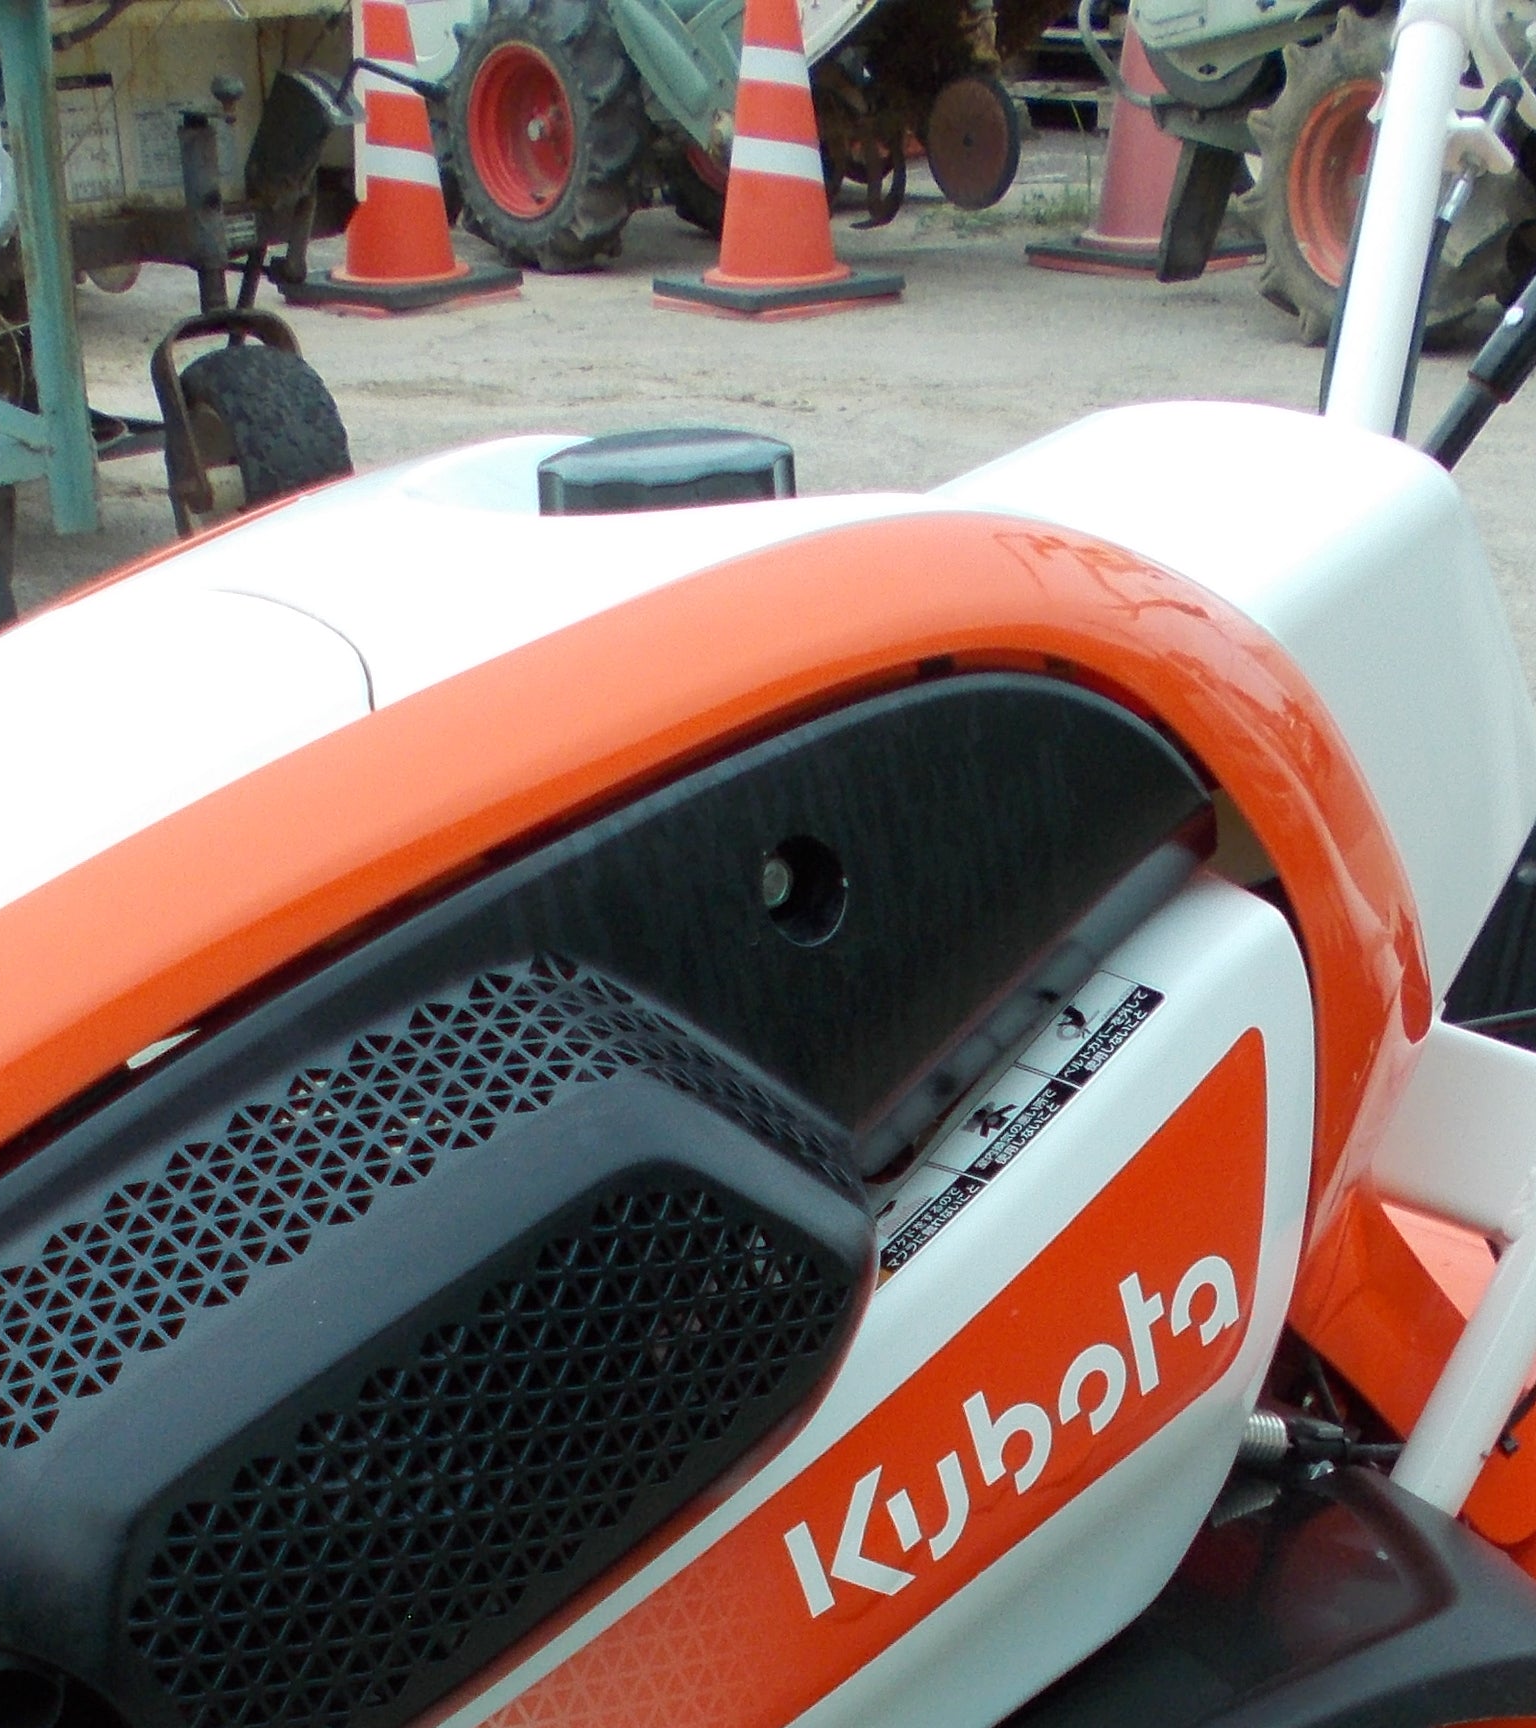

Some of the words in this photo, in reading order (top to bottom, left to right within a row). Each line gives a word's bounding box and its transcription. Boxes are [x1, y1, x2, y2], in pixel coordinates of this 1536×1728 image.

[1084, 1010, 1147, 1072] 使用しないこと
[783, 1255, 1240, 1619] Kubota
